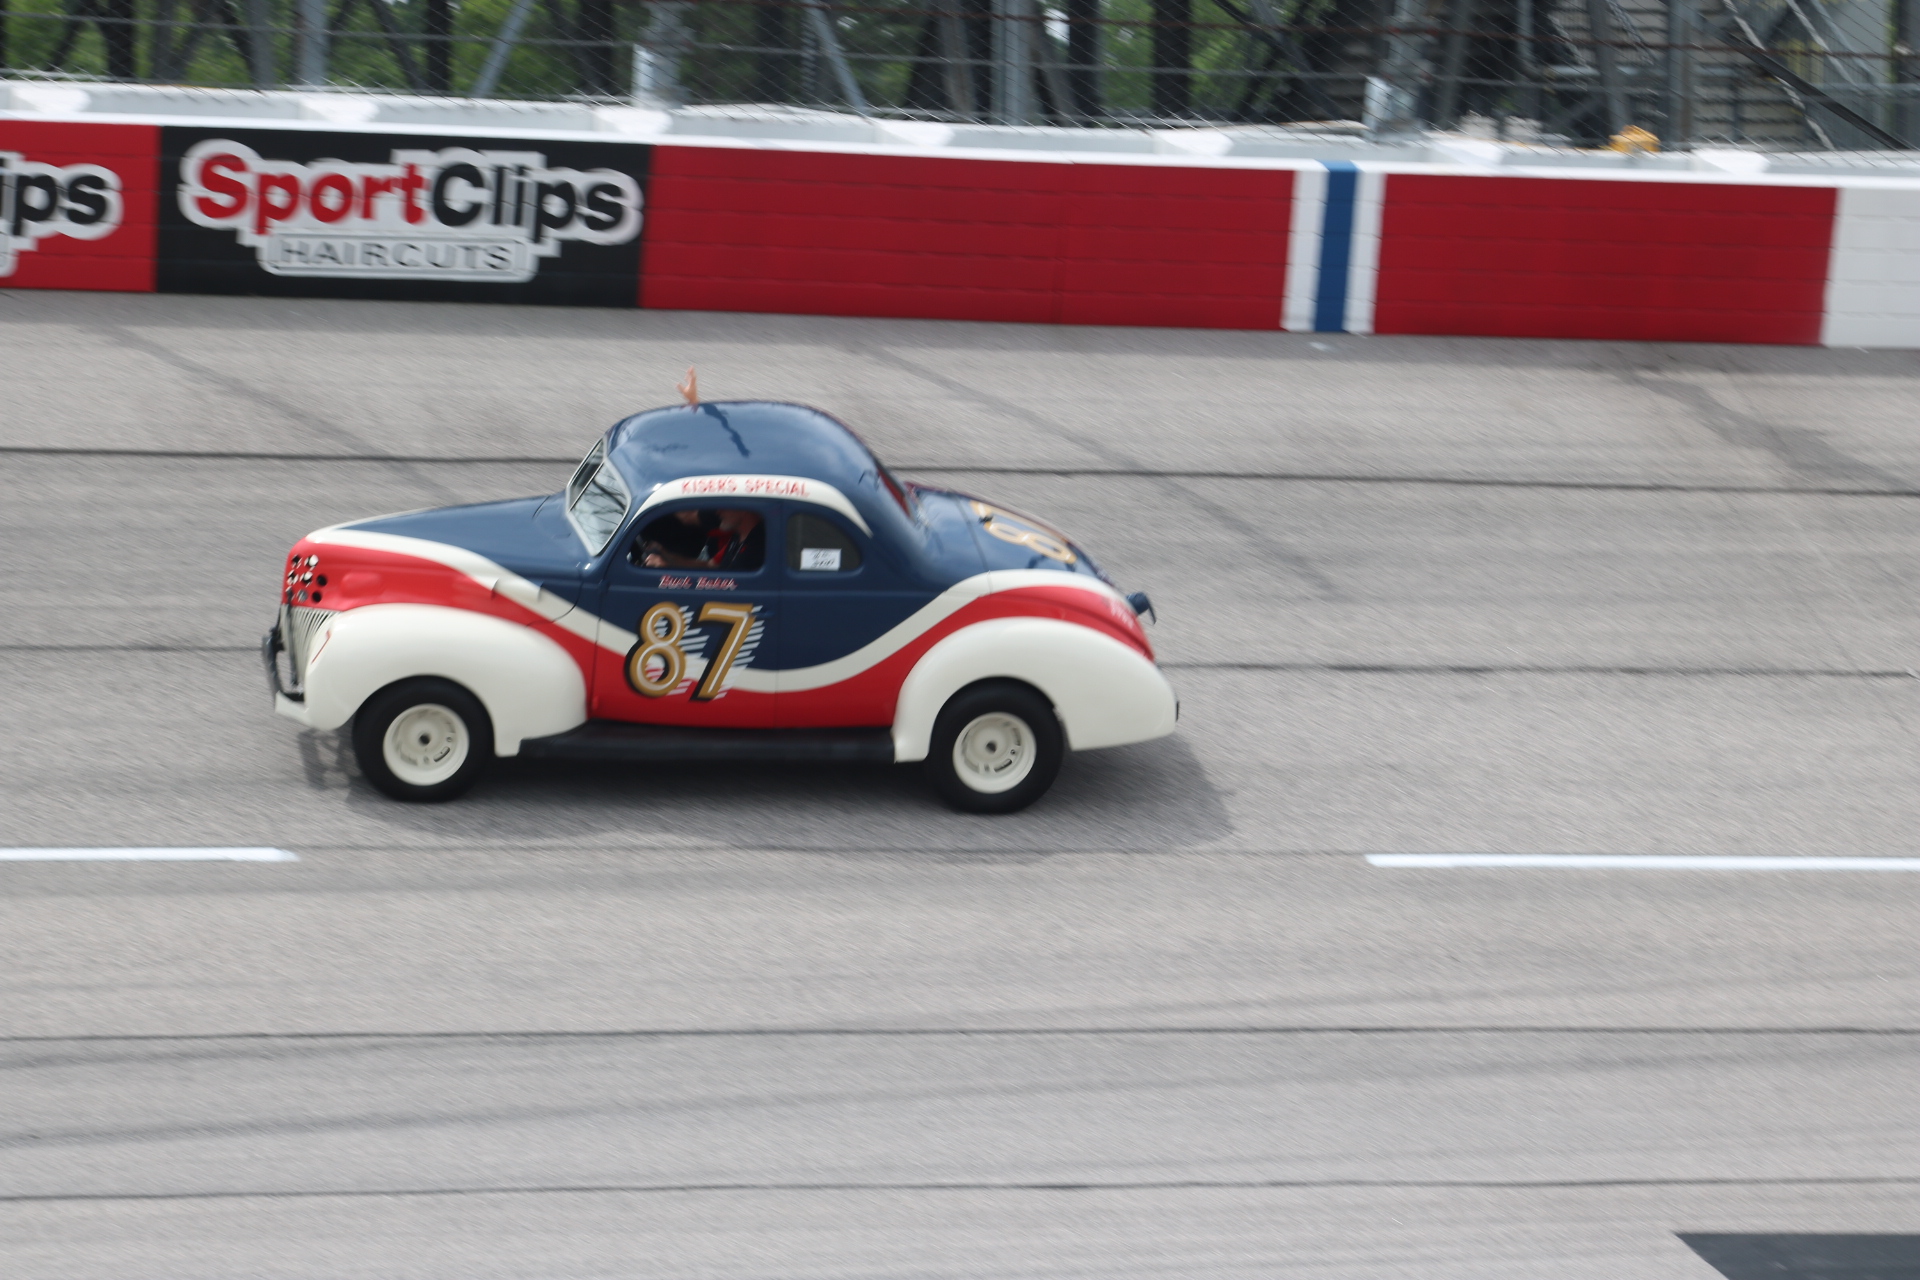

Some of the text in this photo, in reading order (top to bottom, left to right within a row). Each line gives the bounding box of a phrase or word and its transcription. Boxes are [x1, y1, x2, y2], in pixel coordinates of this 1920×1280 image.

[280, 238, 512, 271] HAIRCUTS
[744, 479, 810, 498] SPECIAL
[626, 602, 760, 702] 87
